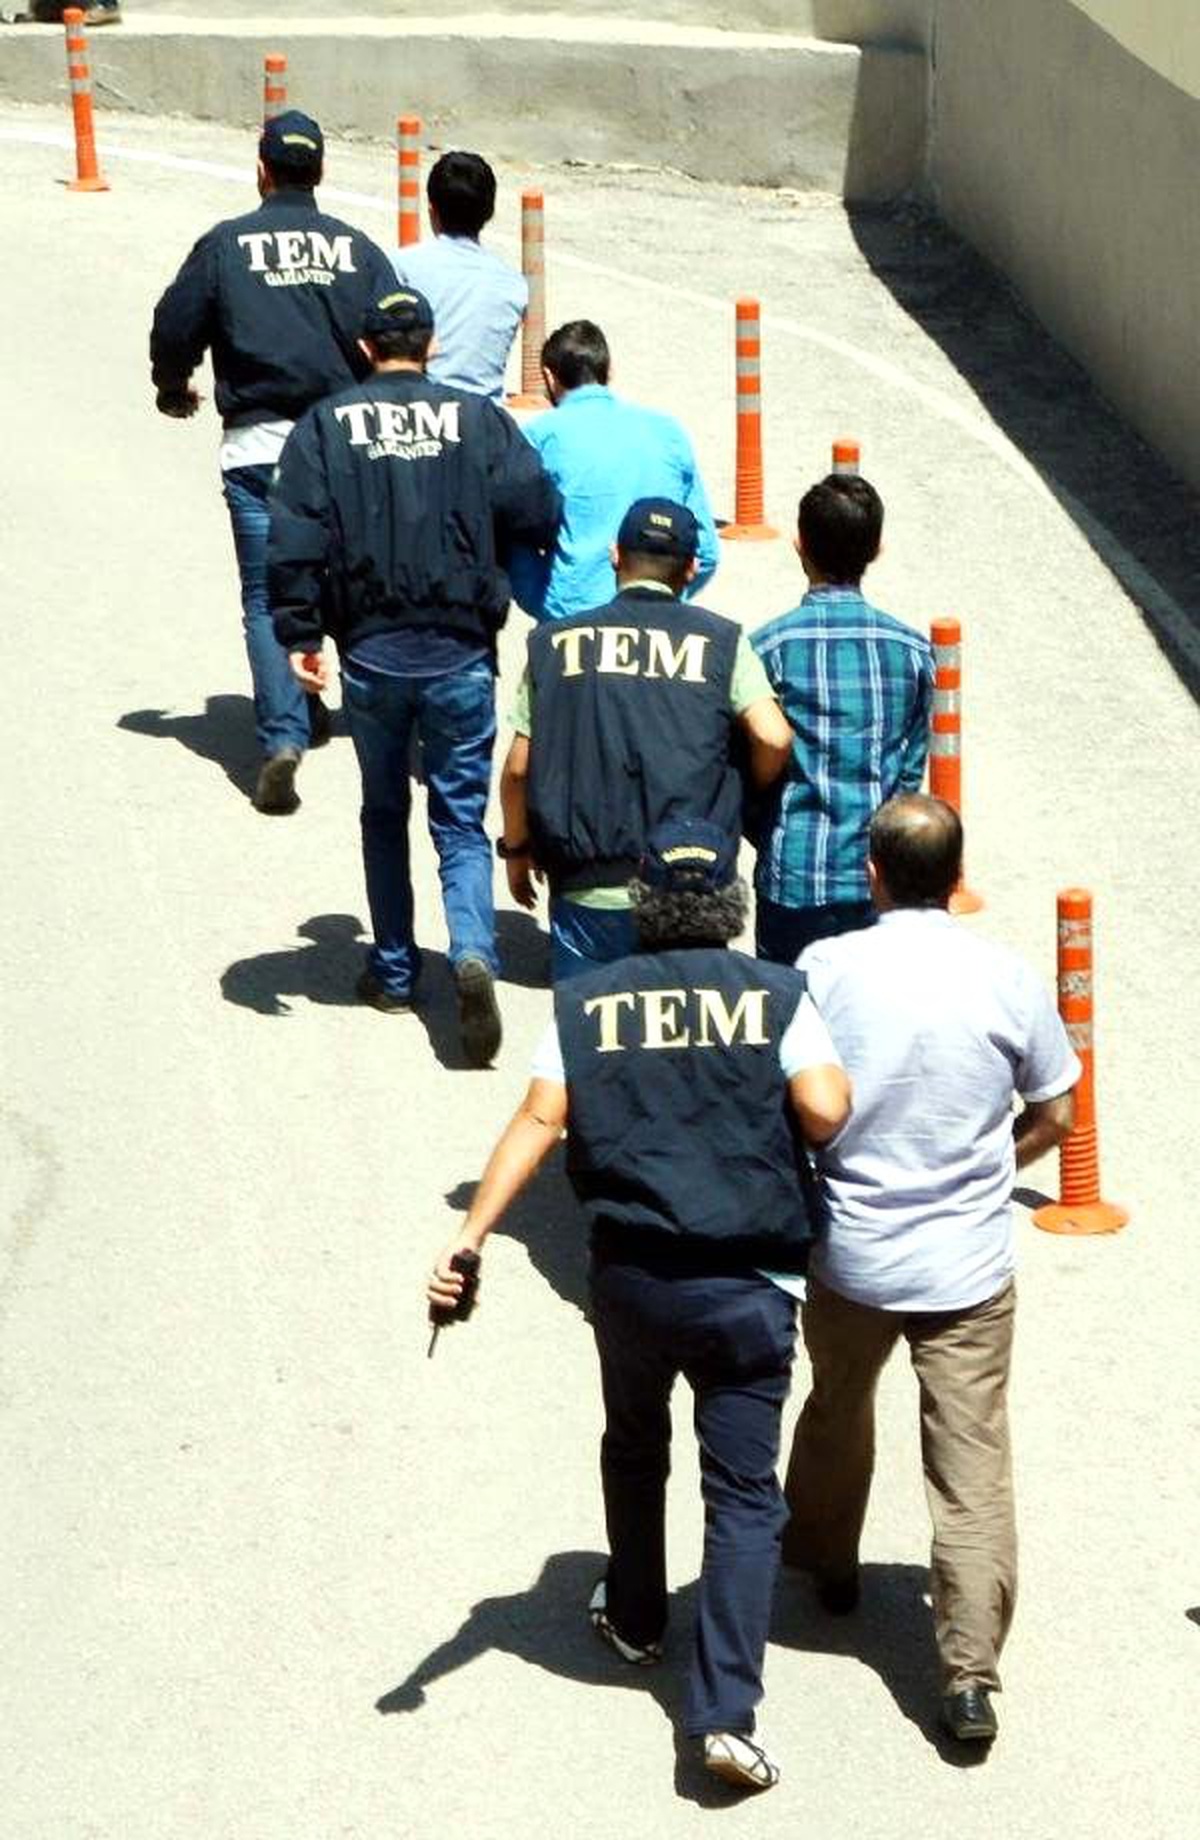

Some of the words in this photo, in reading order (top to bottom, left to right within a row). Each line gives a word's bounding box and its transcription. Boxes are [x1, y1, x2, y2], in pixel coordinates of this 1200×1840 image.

[237, 231, 357, 272] TEM
[334, 401, 461, 445] TEM
[551, 626, 711, 682] TEM
[584, 988, 771, 1052] TEM
